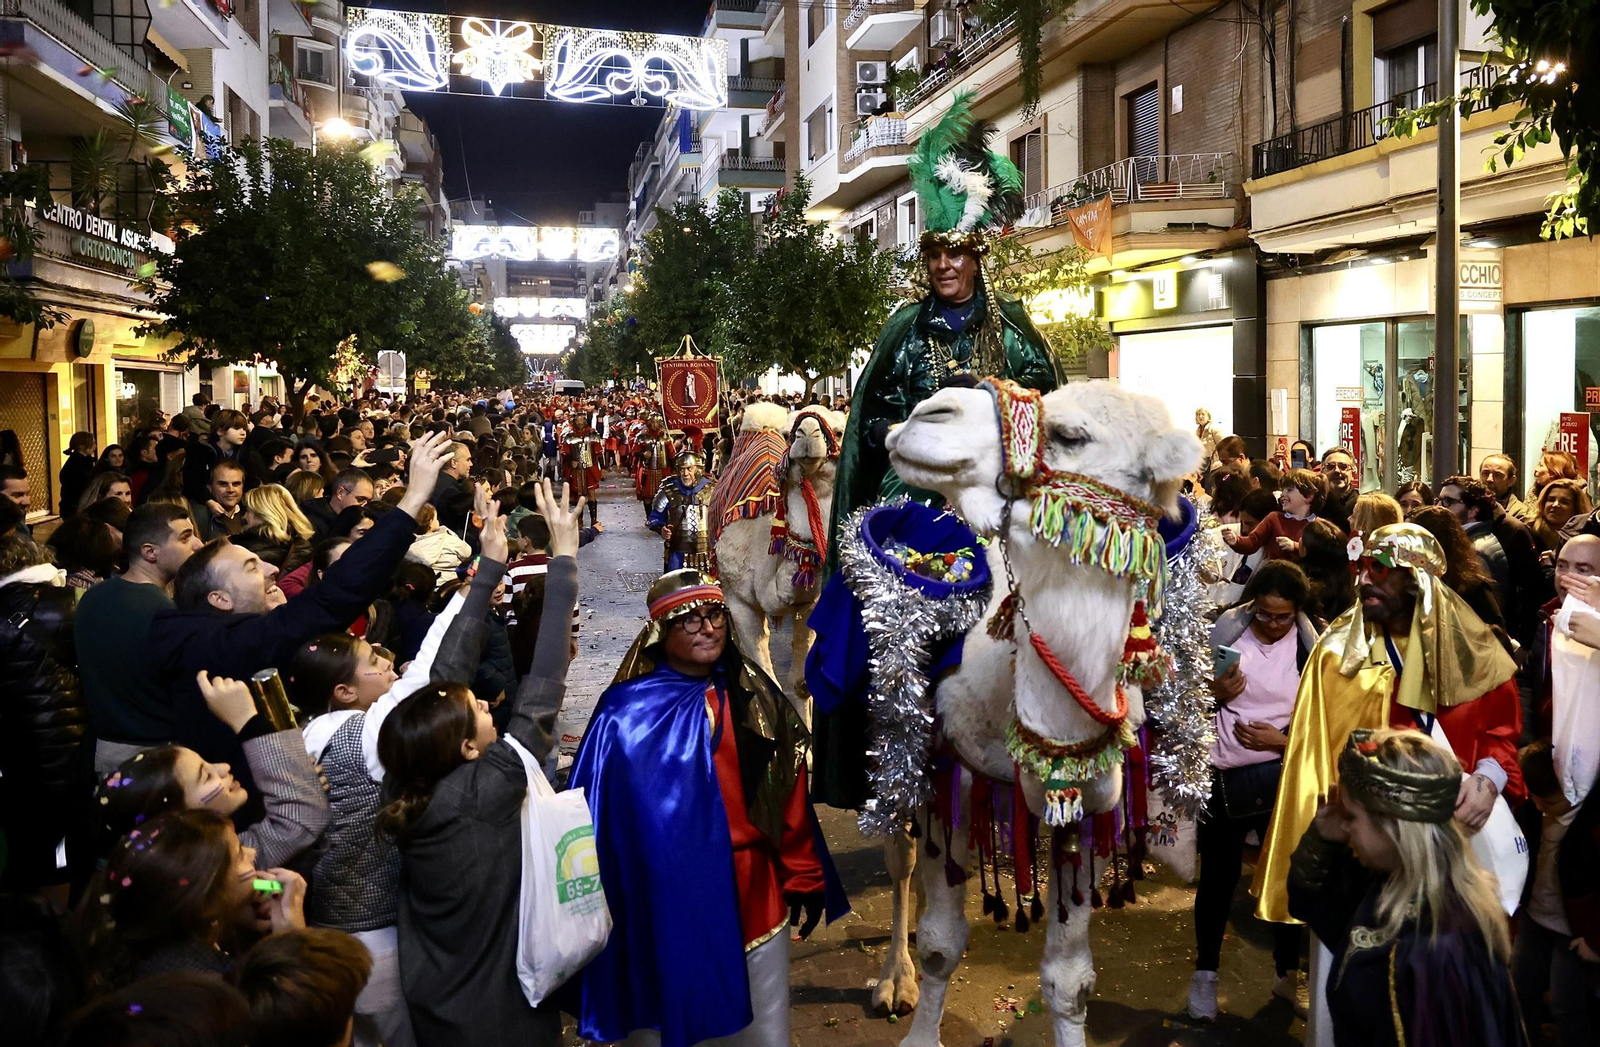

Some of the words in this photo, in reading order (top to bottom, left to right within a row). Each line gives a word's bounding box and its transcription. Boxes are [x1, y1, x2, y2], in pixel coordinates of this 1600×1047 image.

[85, 213, 118, 243] DENTAL
[79, 236, 135, 269] ORTODONCIA
[1460, 264, 1502, 284] CCHIO
[1467, 290, 1503, 299] CONCEPT
[1342, 422, 1353, 439] RE
[1561, 432, 1578, 453] RE
